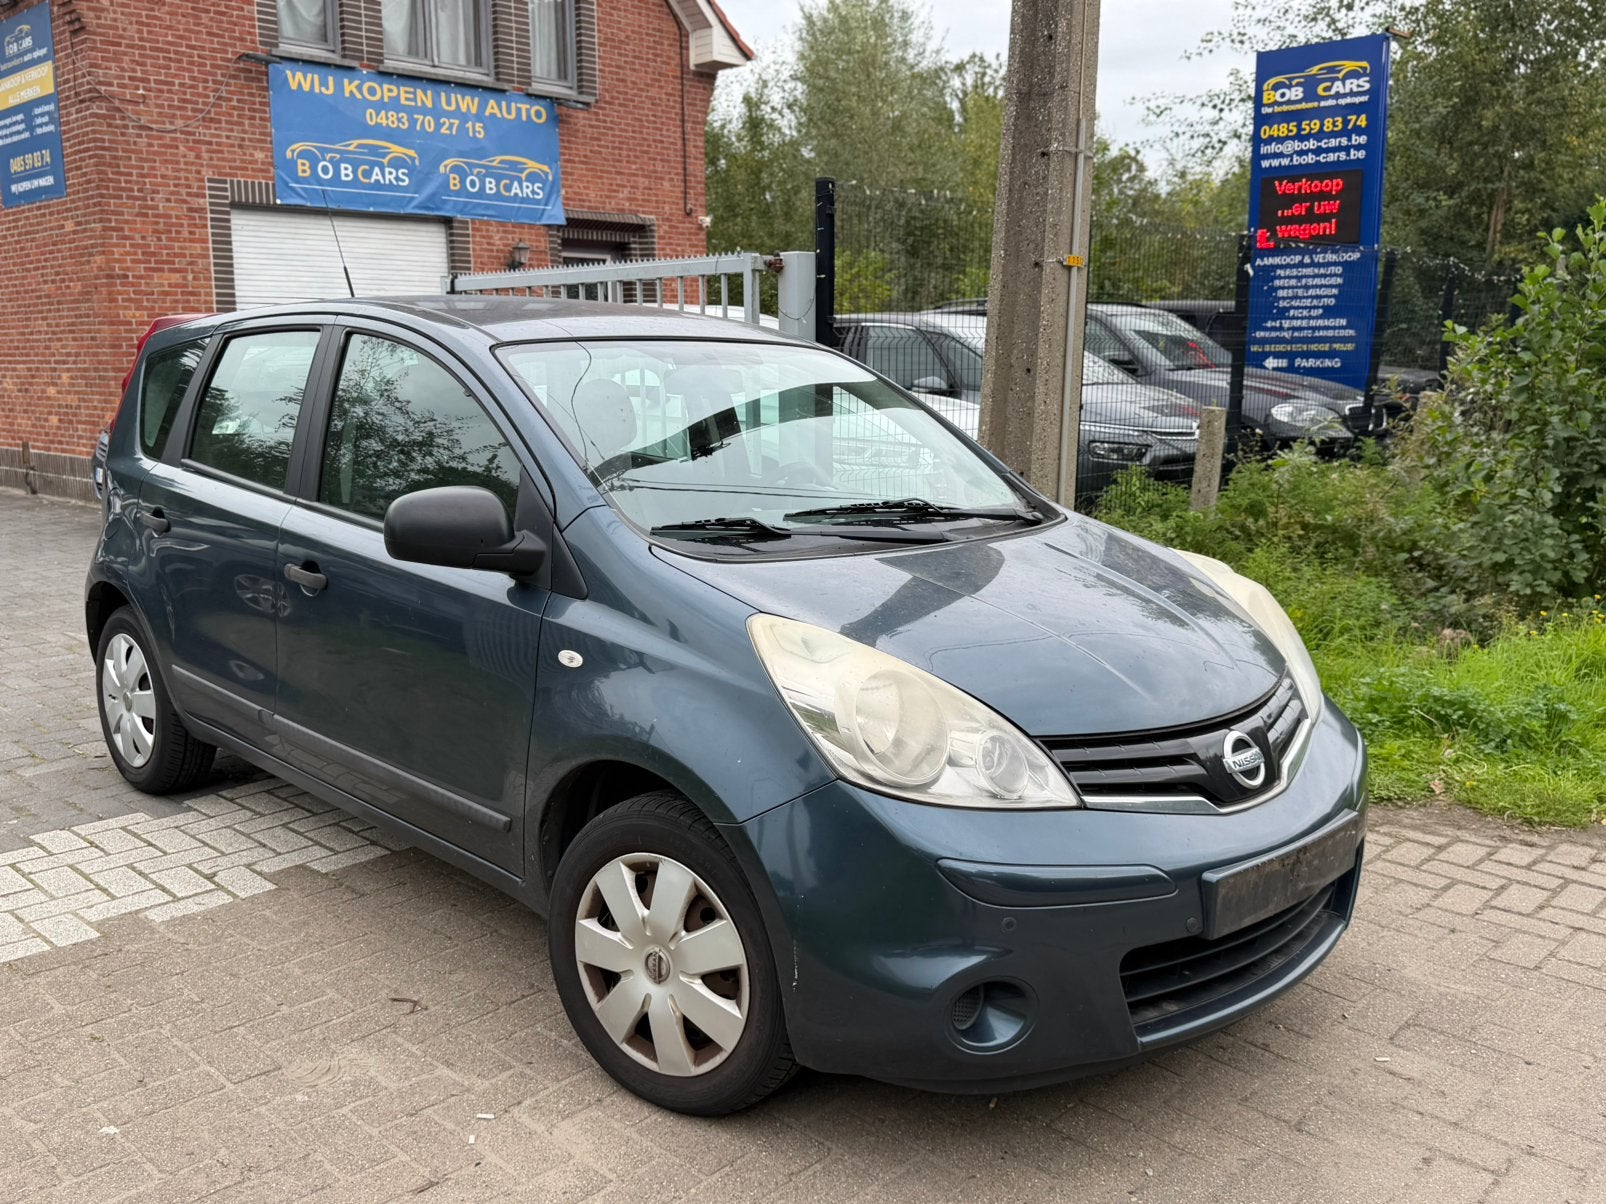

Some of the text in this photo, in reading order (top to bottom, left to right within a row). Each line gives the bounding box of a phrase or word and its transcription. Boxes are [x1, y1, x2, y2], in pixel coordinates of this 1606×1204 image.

[286, 70, 547, 124] WIJ KOPEN UW AUTO
[1263, 77, 1370, 104] BOB CARS
[1262, 95, 1369, 114] Uw betrouwbare auto opkoper
[366, 109, 485, 139] 0483 70 27 15
[1261, 114, 1367, 139] 0485 59 83 74
[1260, 134, 1367, 155] info@bob-cars.be
[25, 153, 33, 170] 59
[42, 149, 51, 165] 74
[1261, 148, 1366, 168] www.bob-cars.be
[1274, 178, 1344, 195] Verkoop
[1255, 251, 1361, 266] AANKOOP & VERKOOP
[1277, 288, 1338, 297] BESTELWAGEN
[1279, 298, 1335, 307] SCHADEAUTO
[1289, 308, 1323, 317] PICK-UP
[1295, 358, 1341, 368] PARKING
[1232, 751, 1263, 769] NISSAN
